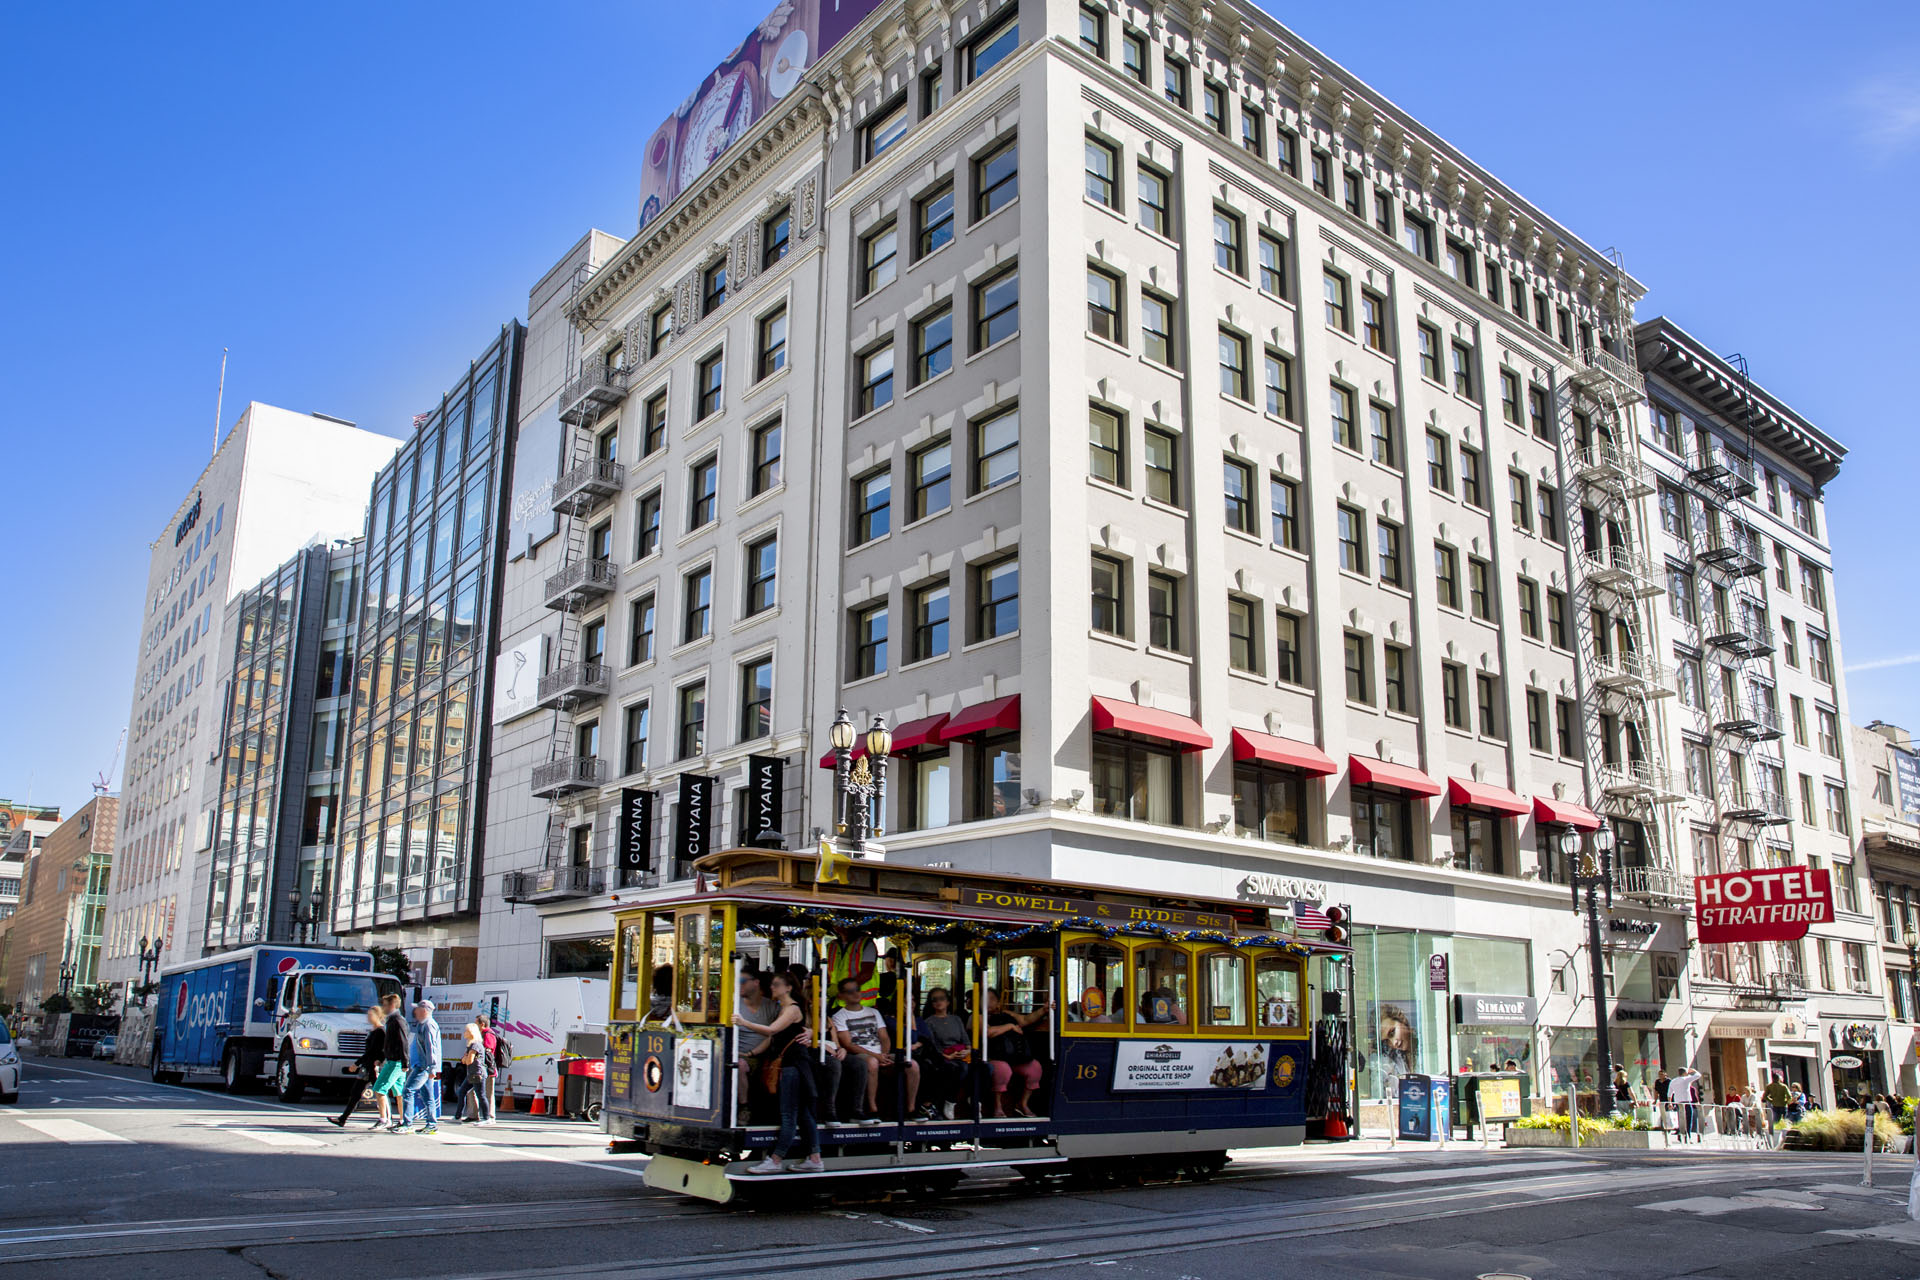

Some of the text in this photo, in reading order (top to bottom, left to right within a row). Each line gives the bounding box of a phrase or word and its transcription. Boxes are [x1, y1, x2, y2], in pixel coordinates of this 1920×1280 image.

[760, 765, 773, 833] UYANA
[629, 796, 643, 864] CUYANA
[688, 782, 702, 855] CUYANA
[1246, 874, 1329, 901] SWAROVSKI
[1700, 871, 1824, 905] HOTEL
[975, 892, 1223, 928] POWELL & HYDE Sts.
[1701, 901, 1825, 926] STRATFORD
[432, 977, 447, 985] RETAIL
[187, 980, 229, 1040] pepsi
[647, 1035, 664, 1053] 16
[1714, 1028, 1767, 1037] HOTEL STRATFORD
[1075, 1064, 1098, 1080] 16
